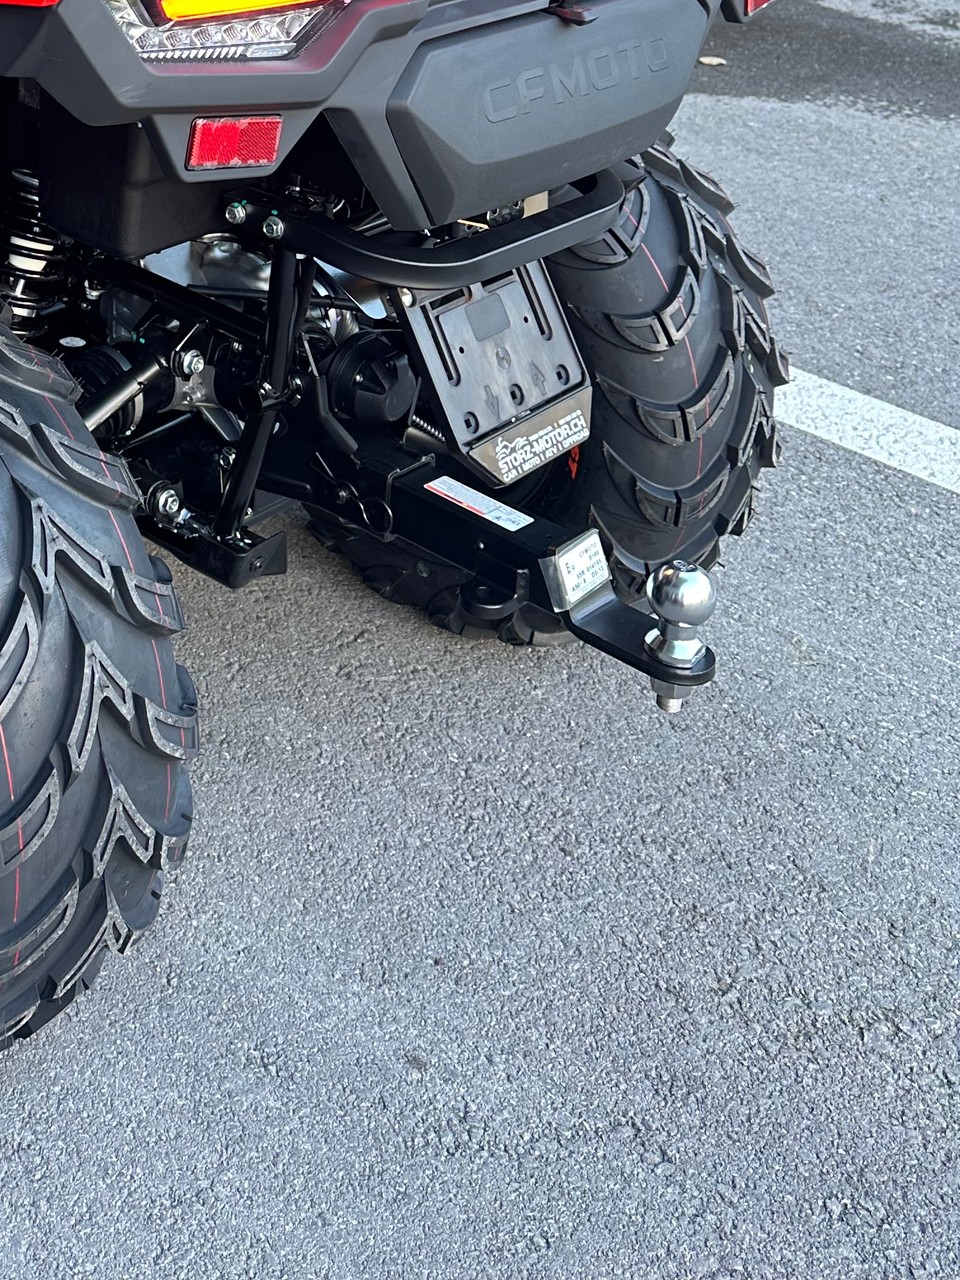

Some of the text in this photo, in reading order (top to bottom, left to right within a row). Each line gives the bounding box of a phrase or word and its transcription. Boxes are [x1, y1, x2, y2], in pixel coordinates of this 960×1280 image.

[483, 37, 670, 124] CFMOTO
[498, 415, 587, 474] STORZ-MOTOR.CH
[503, 468, 518, 482] CAR
[522, 458, 541, 472] MOTO
[546, 445, 558, 460] ATV
